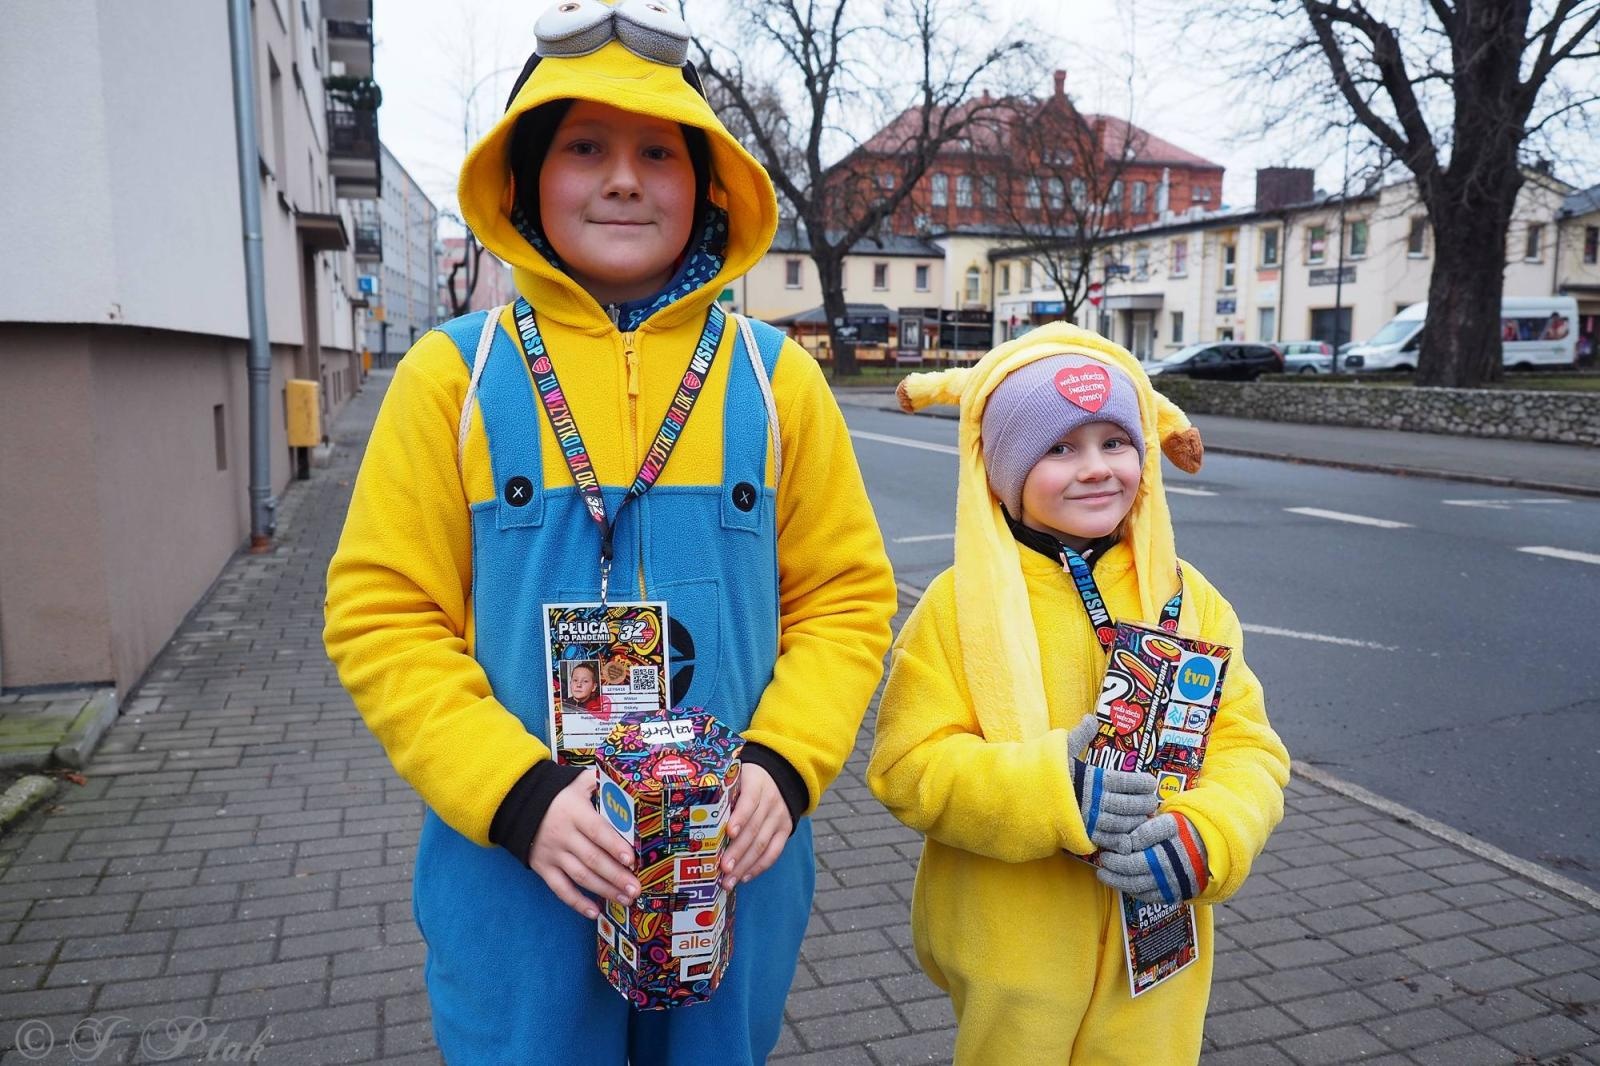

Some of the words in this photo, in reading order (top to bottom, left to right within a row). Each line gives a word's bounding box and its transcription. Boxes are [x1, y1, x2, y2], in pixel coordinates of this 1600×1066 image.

[538, 374, 556, 391] TU
[675, 389, 694, 410] OK!
[544, 388, 577, 448] WSZYSTKO
[665, 406, 687, 431] GRA
[566, 447, 588, 470] GRA
[641, 425, 677, 485] WSZYSTKO
[576, 469, 599, 492] OK!
[631, 480, 647, 496] TU
[558, 621, 609, 636] PŁUCA
[620, 621, 647, 641] 32
[1184, 668, 1210, 688] tvn
[1097, 674, 1130, 715] 2
[606, 791, 628, 822] tvn
[1139, 903, 1170, 921] PŁU
[1140, 921, 1149, 929] PO
